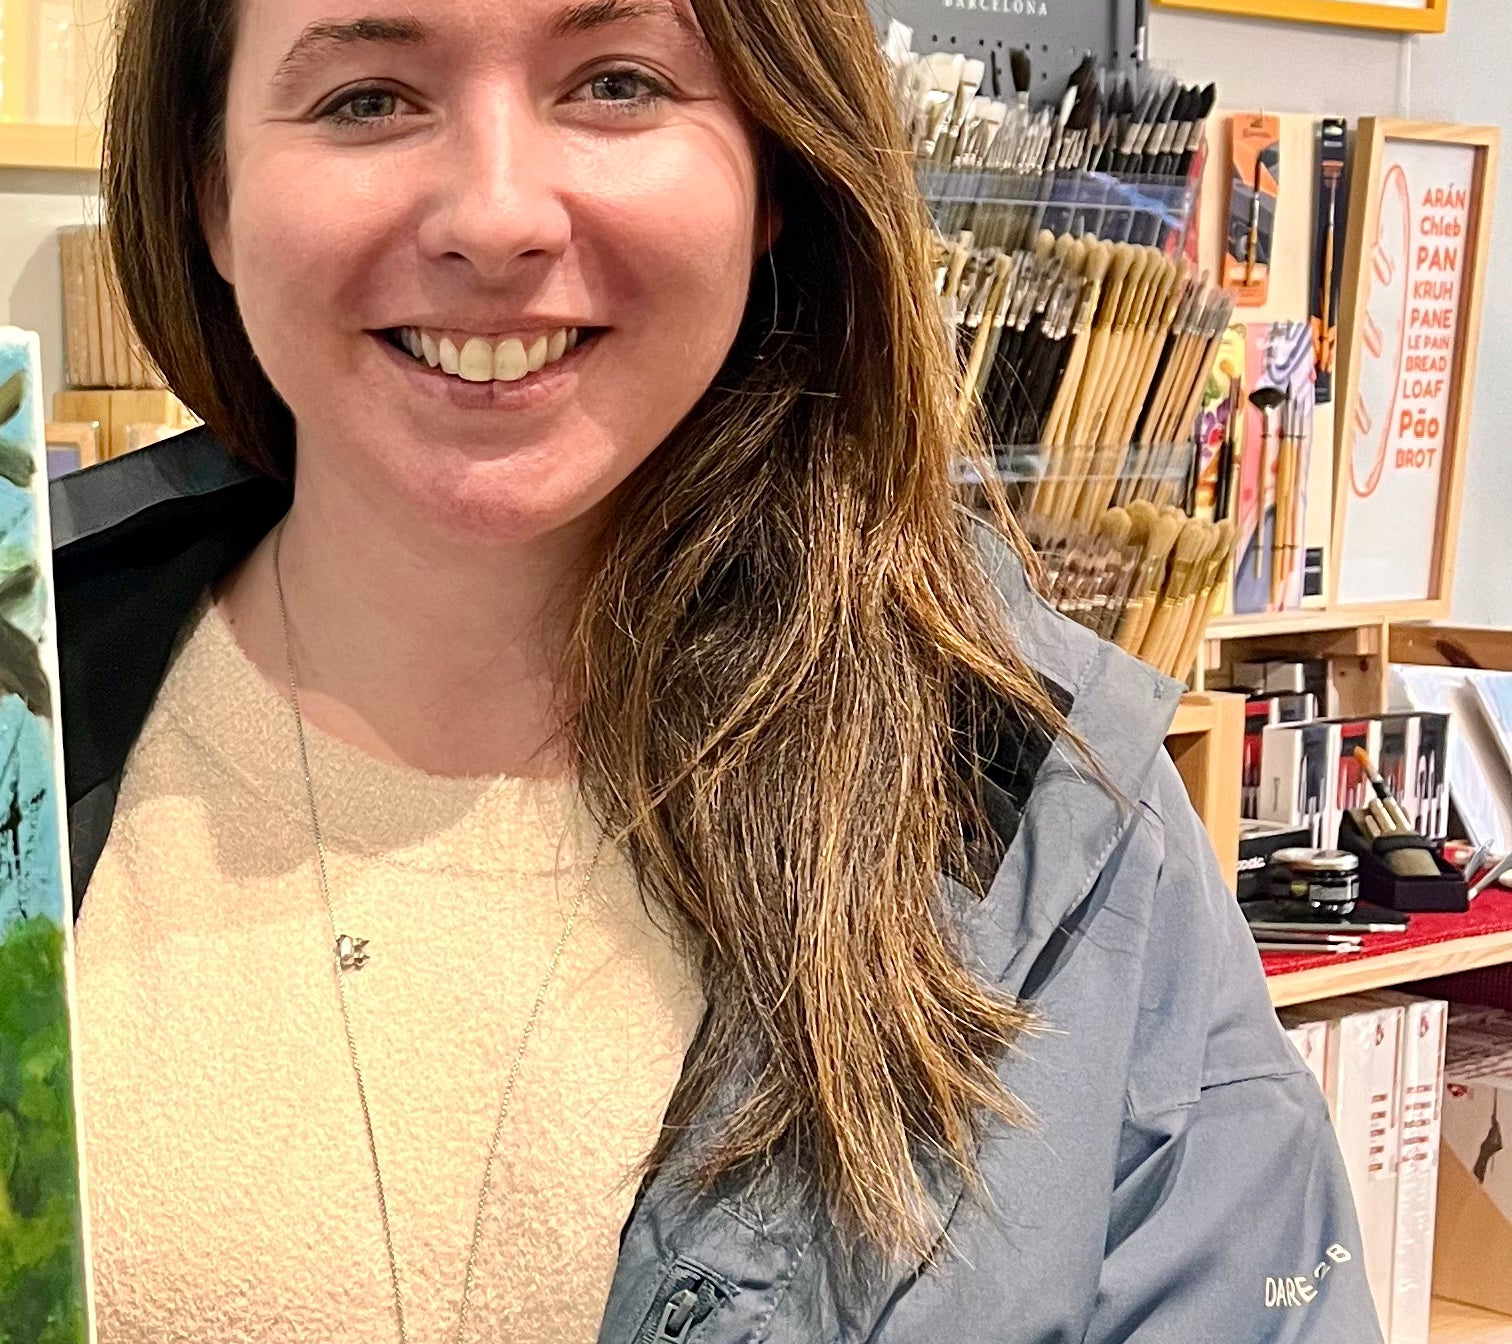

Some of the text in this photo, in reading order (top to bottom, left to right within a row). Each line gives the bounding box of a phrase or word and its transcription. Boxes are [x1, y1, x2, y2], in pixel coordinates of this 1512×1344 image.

[1422, 182, 1467, 209] ARÁN
[1416, 245, 1458, 272] PAN
[1413, 280, 1454, 301] KRUH
[1410, 308, 1453, 329] PANE
[1407, 335, 1450, 350] LE PAIN
[1405, 355, 1447, 372] BREAD
[1402, 379, 1444, 399] LOAF
[1399, 407, 1440, 439] Pão
[1395, 448, 1437, 468] BROT
[1265, 1276, 1319, 1307] DARE
